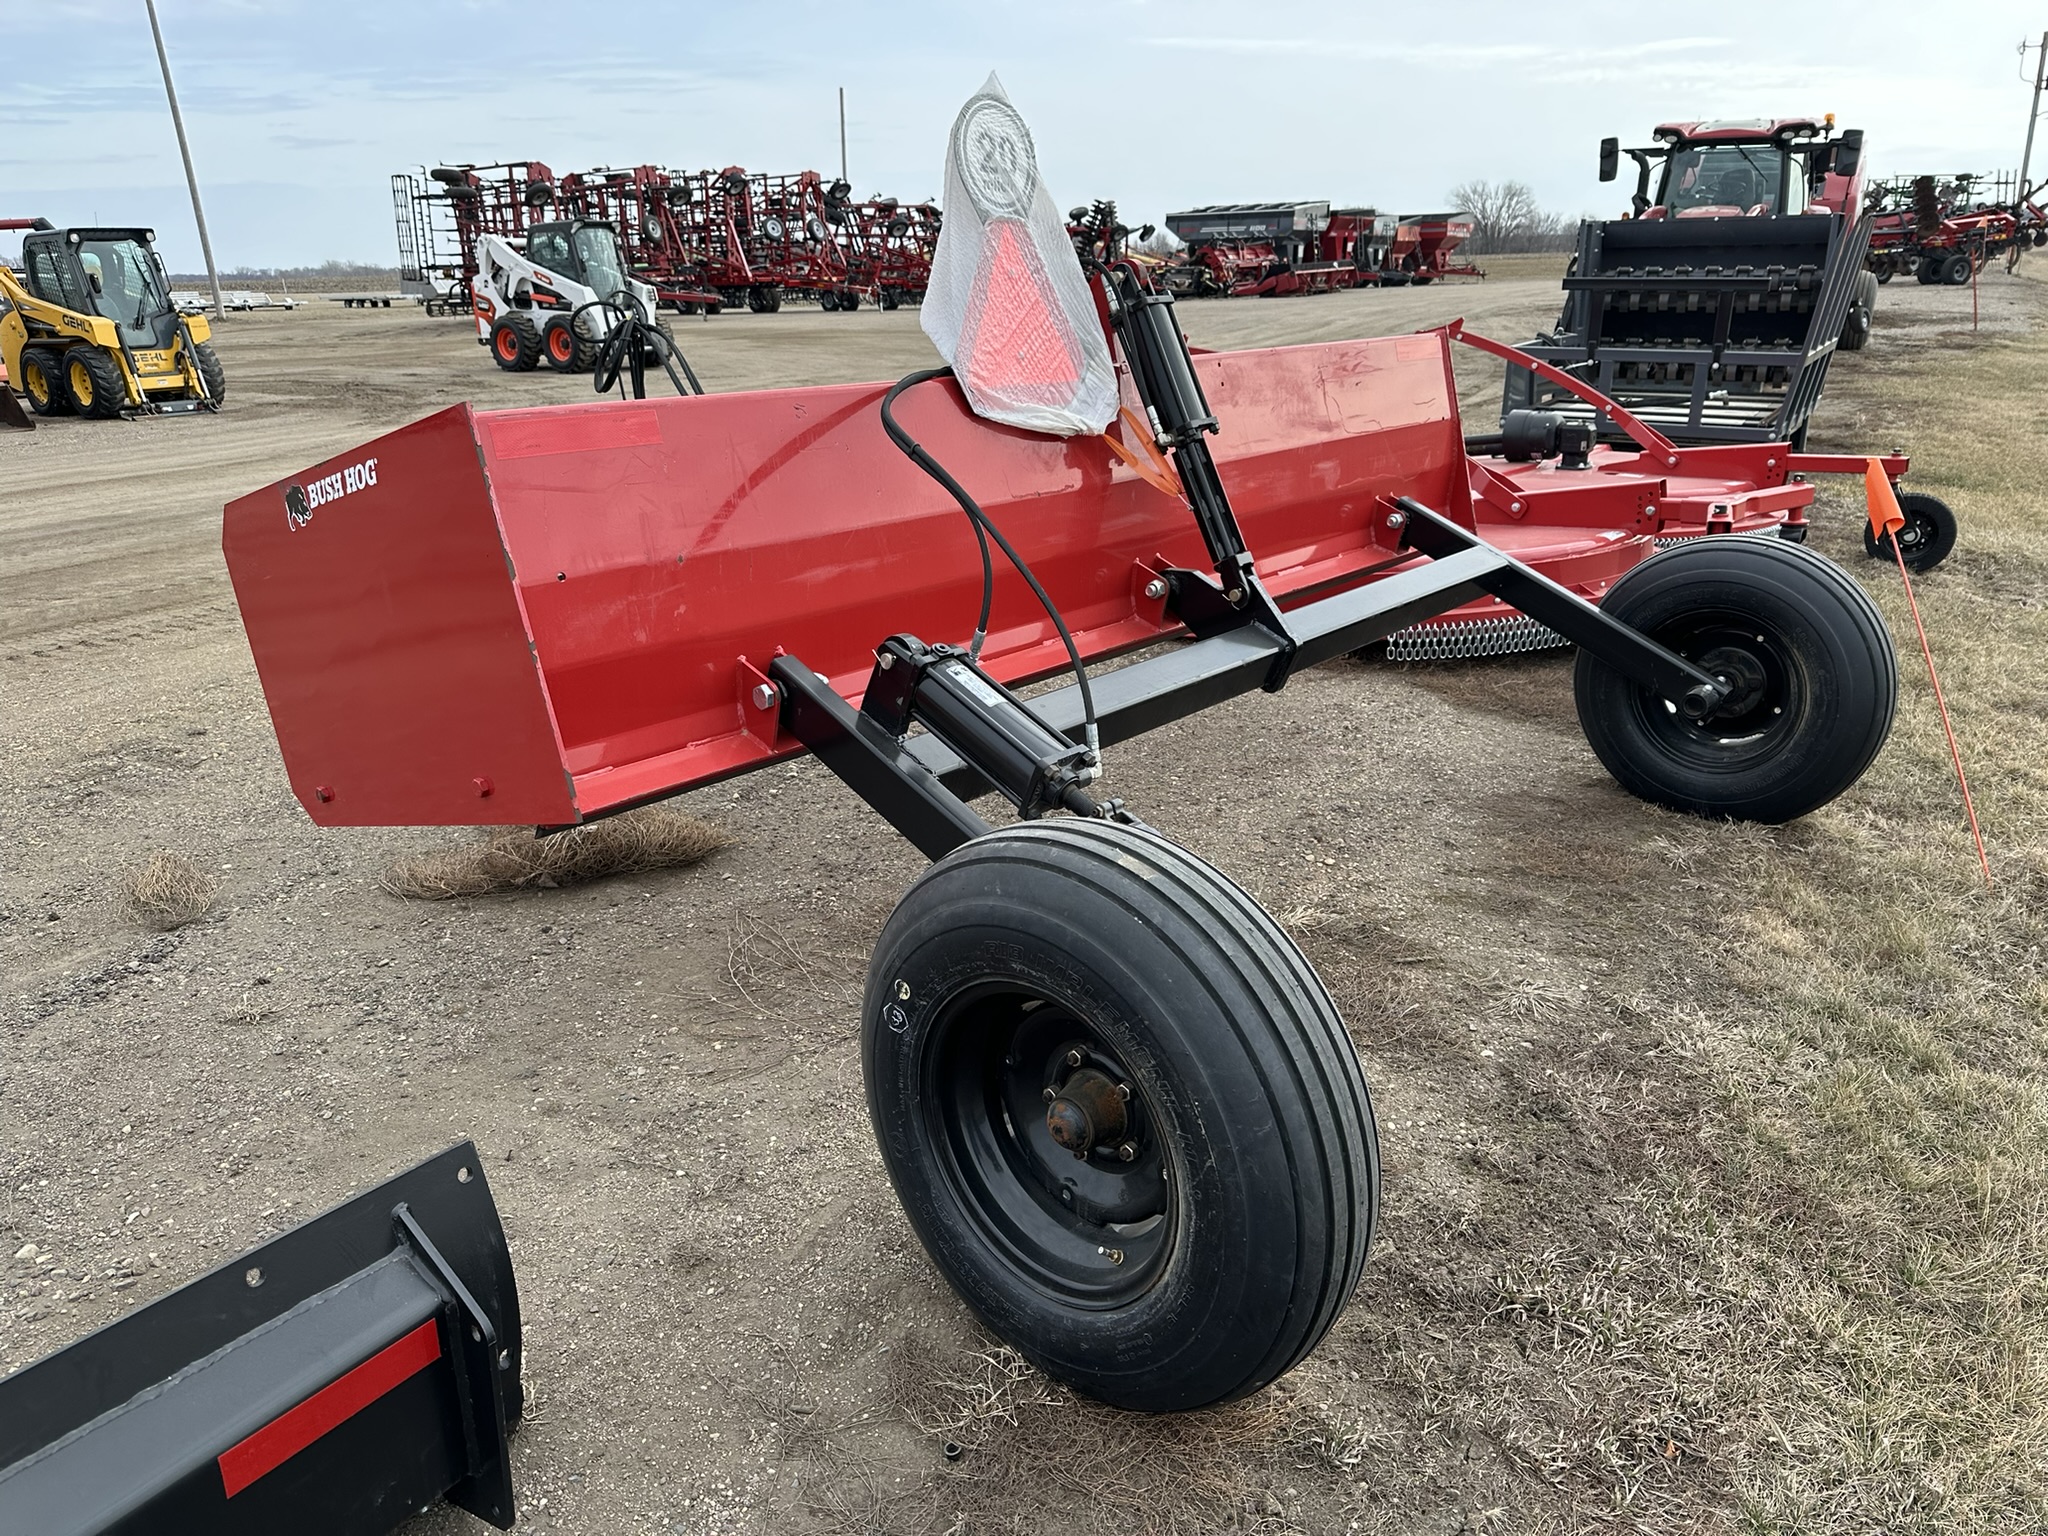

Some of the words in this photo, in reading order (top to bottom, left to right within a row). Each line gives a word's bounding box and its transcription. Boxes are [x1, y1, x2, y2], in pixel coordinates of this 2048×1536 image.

[62, 314, 90, 333] GEHL
[307, 472, 344, 509] BUSH
[344, 458, 378, 494] HOG
[984, 940, 1024, 964] RIB
